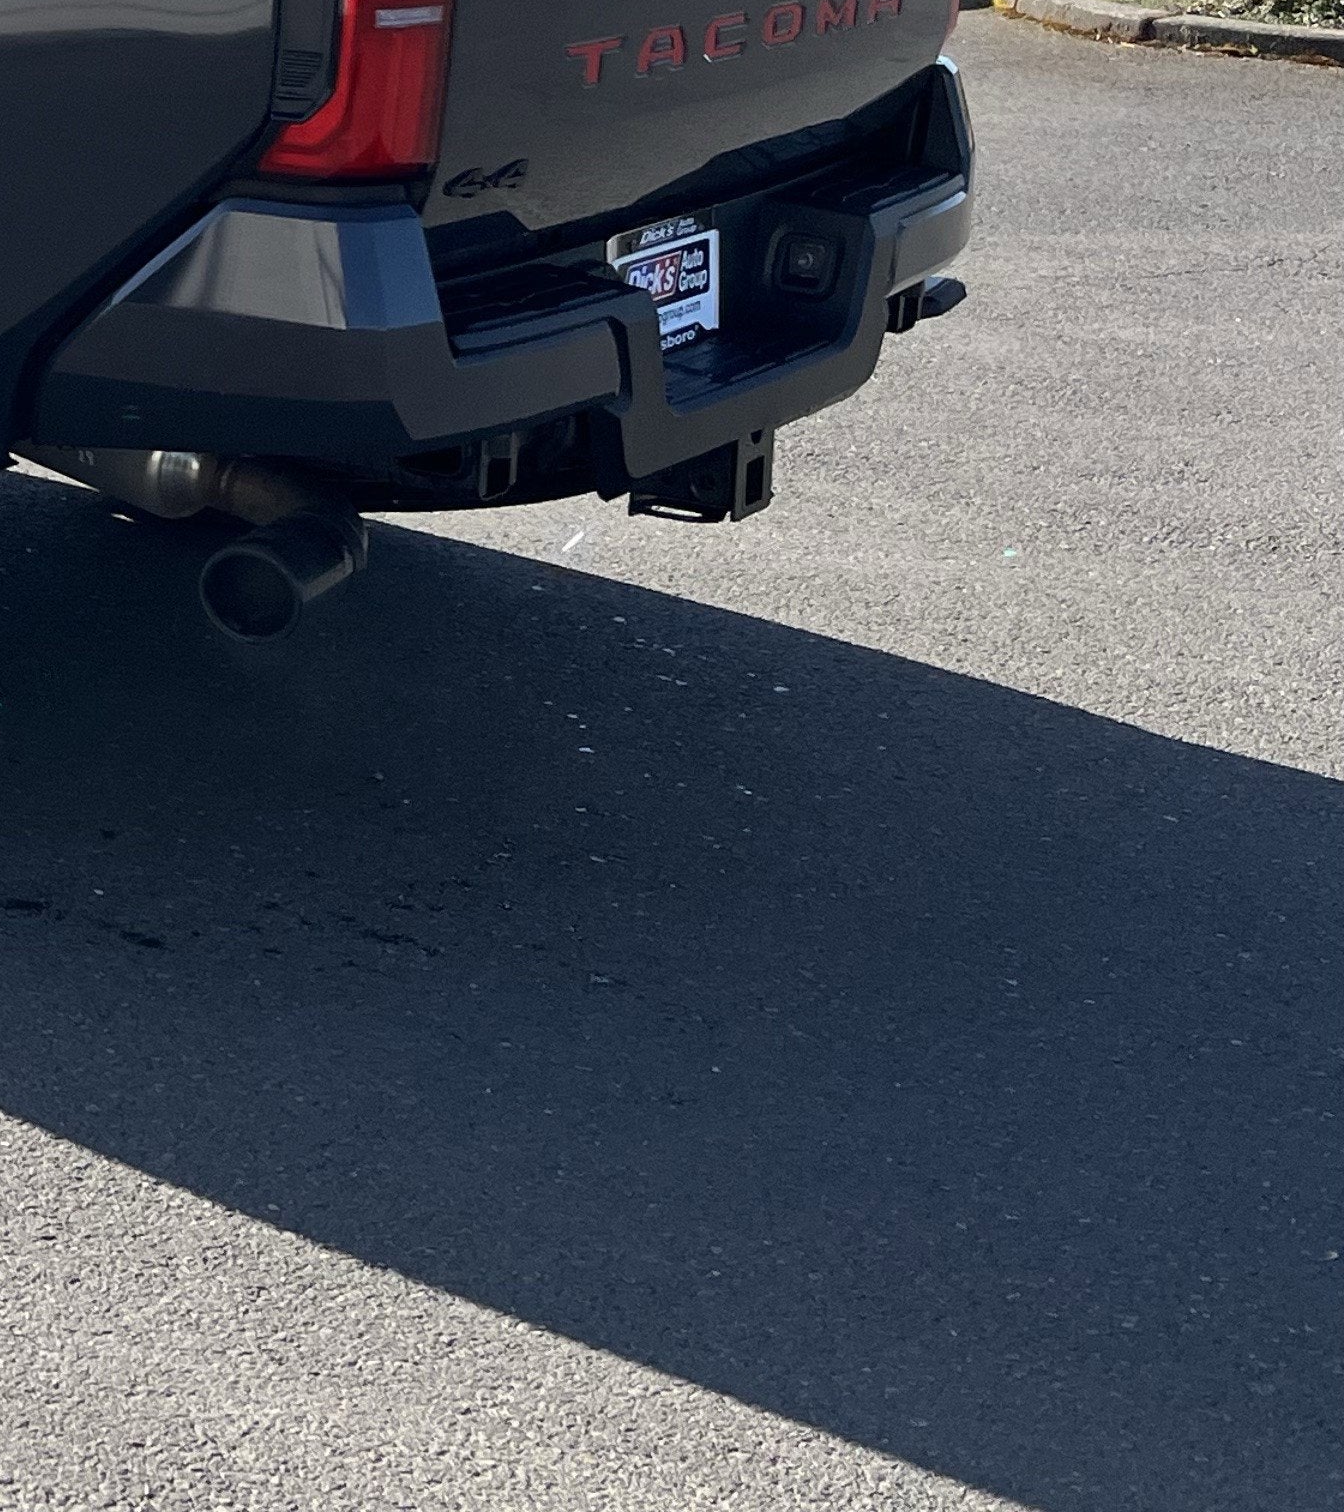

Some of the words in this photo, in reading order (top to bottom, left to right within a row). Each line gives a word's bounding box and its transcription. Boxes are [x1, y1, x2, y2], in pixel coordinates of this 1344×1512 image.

[681, 248, 704, 271] Auto
[628, 259, 676, 295] Dick's
[678, 269, 707, 293] Group
